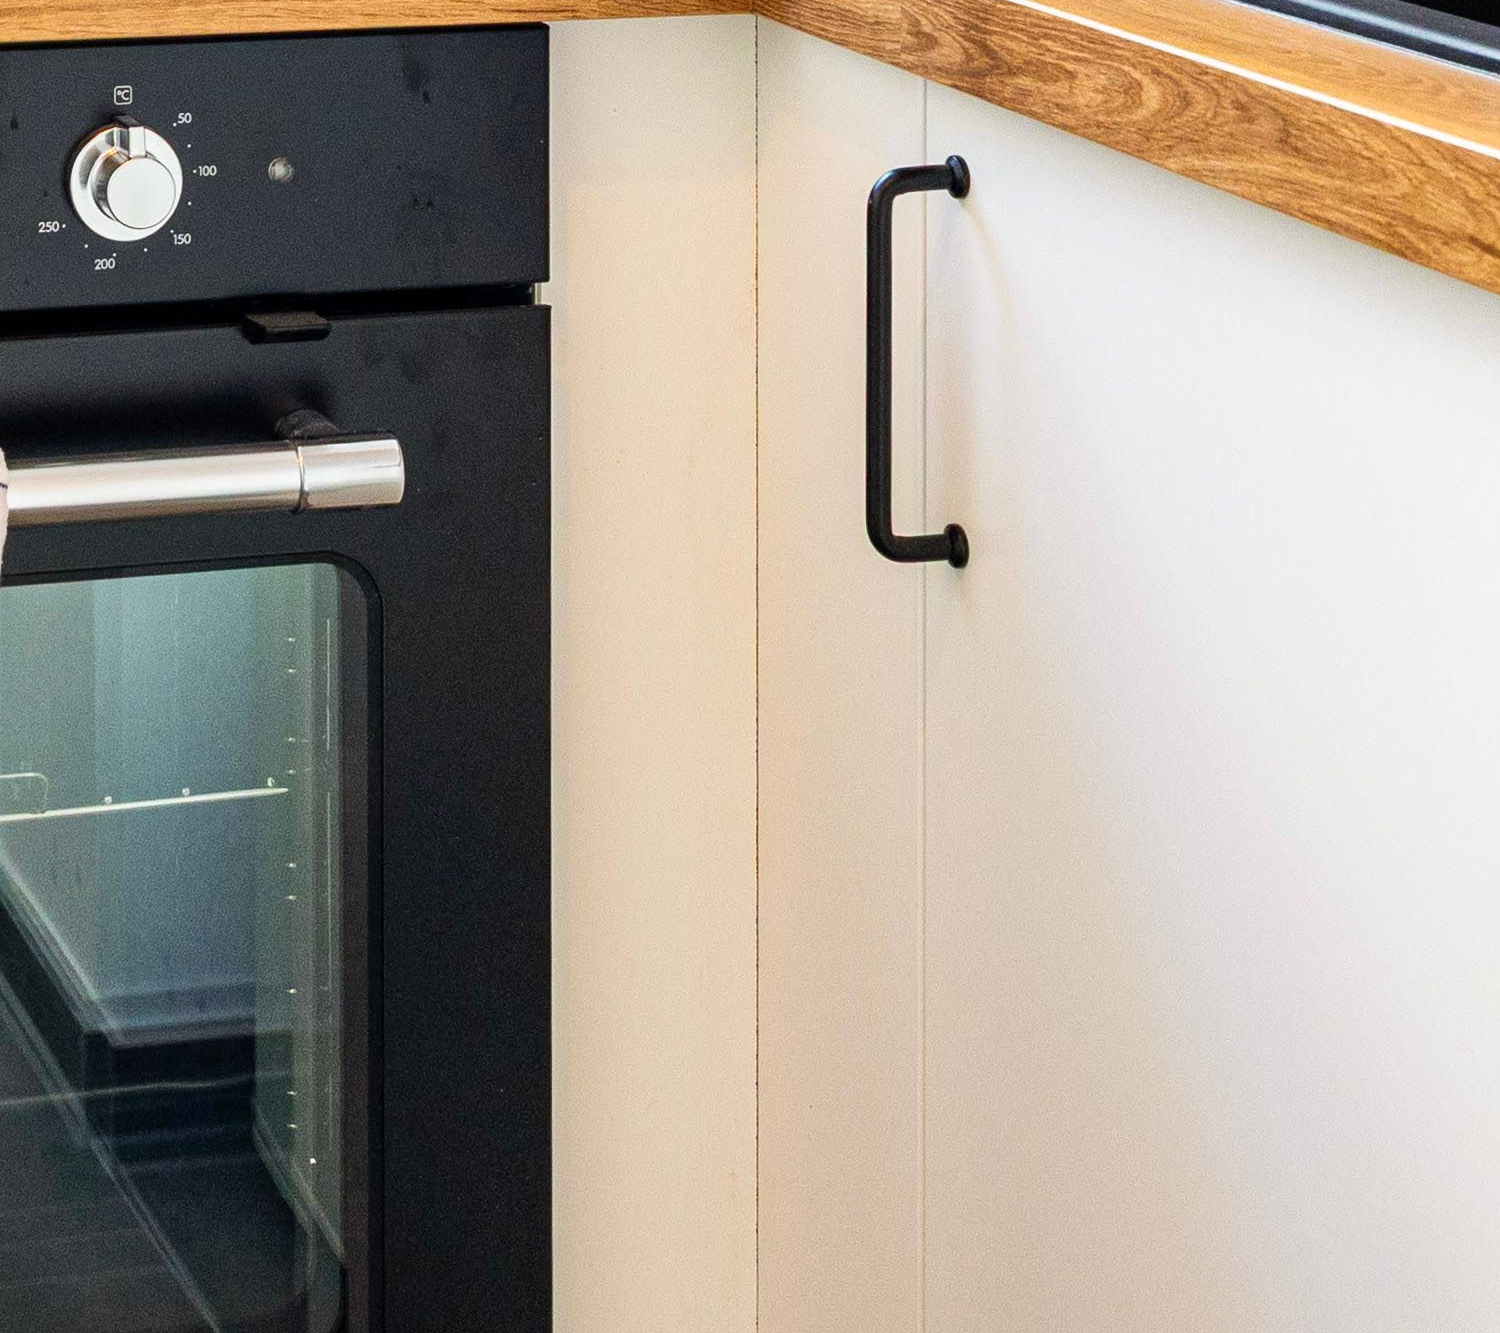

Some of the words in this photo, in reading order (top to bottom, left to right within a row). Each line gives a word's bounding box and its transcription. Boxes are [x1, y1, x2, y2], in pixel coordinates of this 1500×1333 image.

[177, 112, 192, 124] 50
[197, 165, 217, 177] 100
[37, 220, 60, 233] 250
[172, 233, 192, 245] 150
[94, 258, 116, 271] 200
